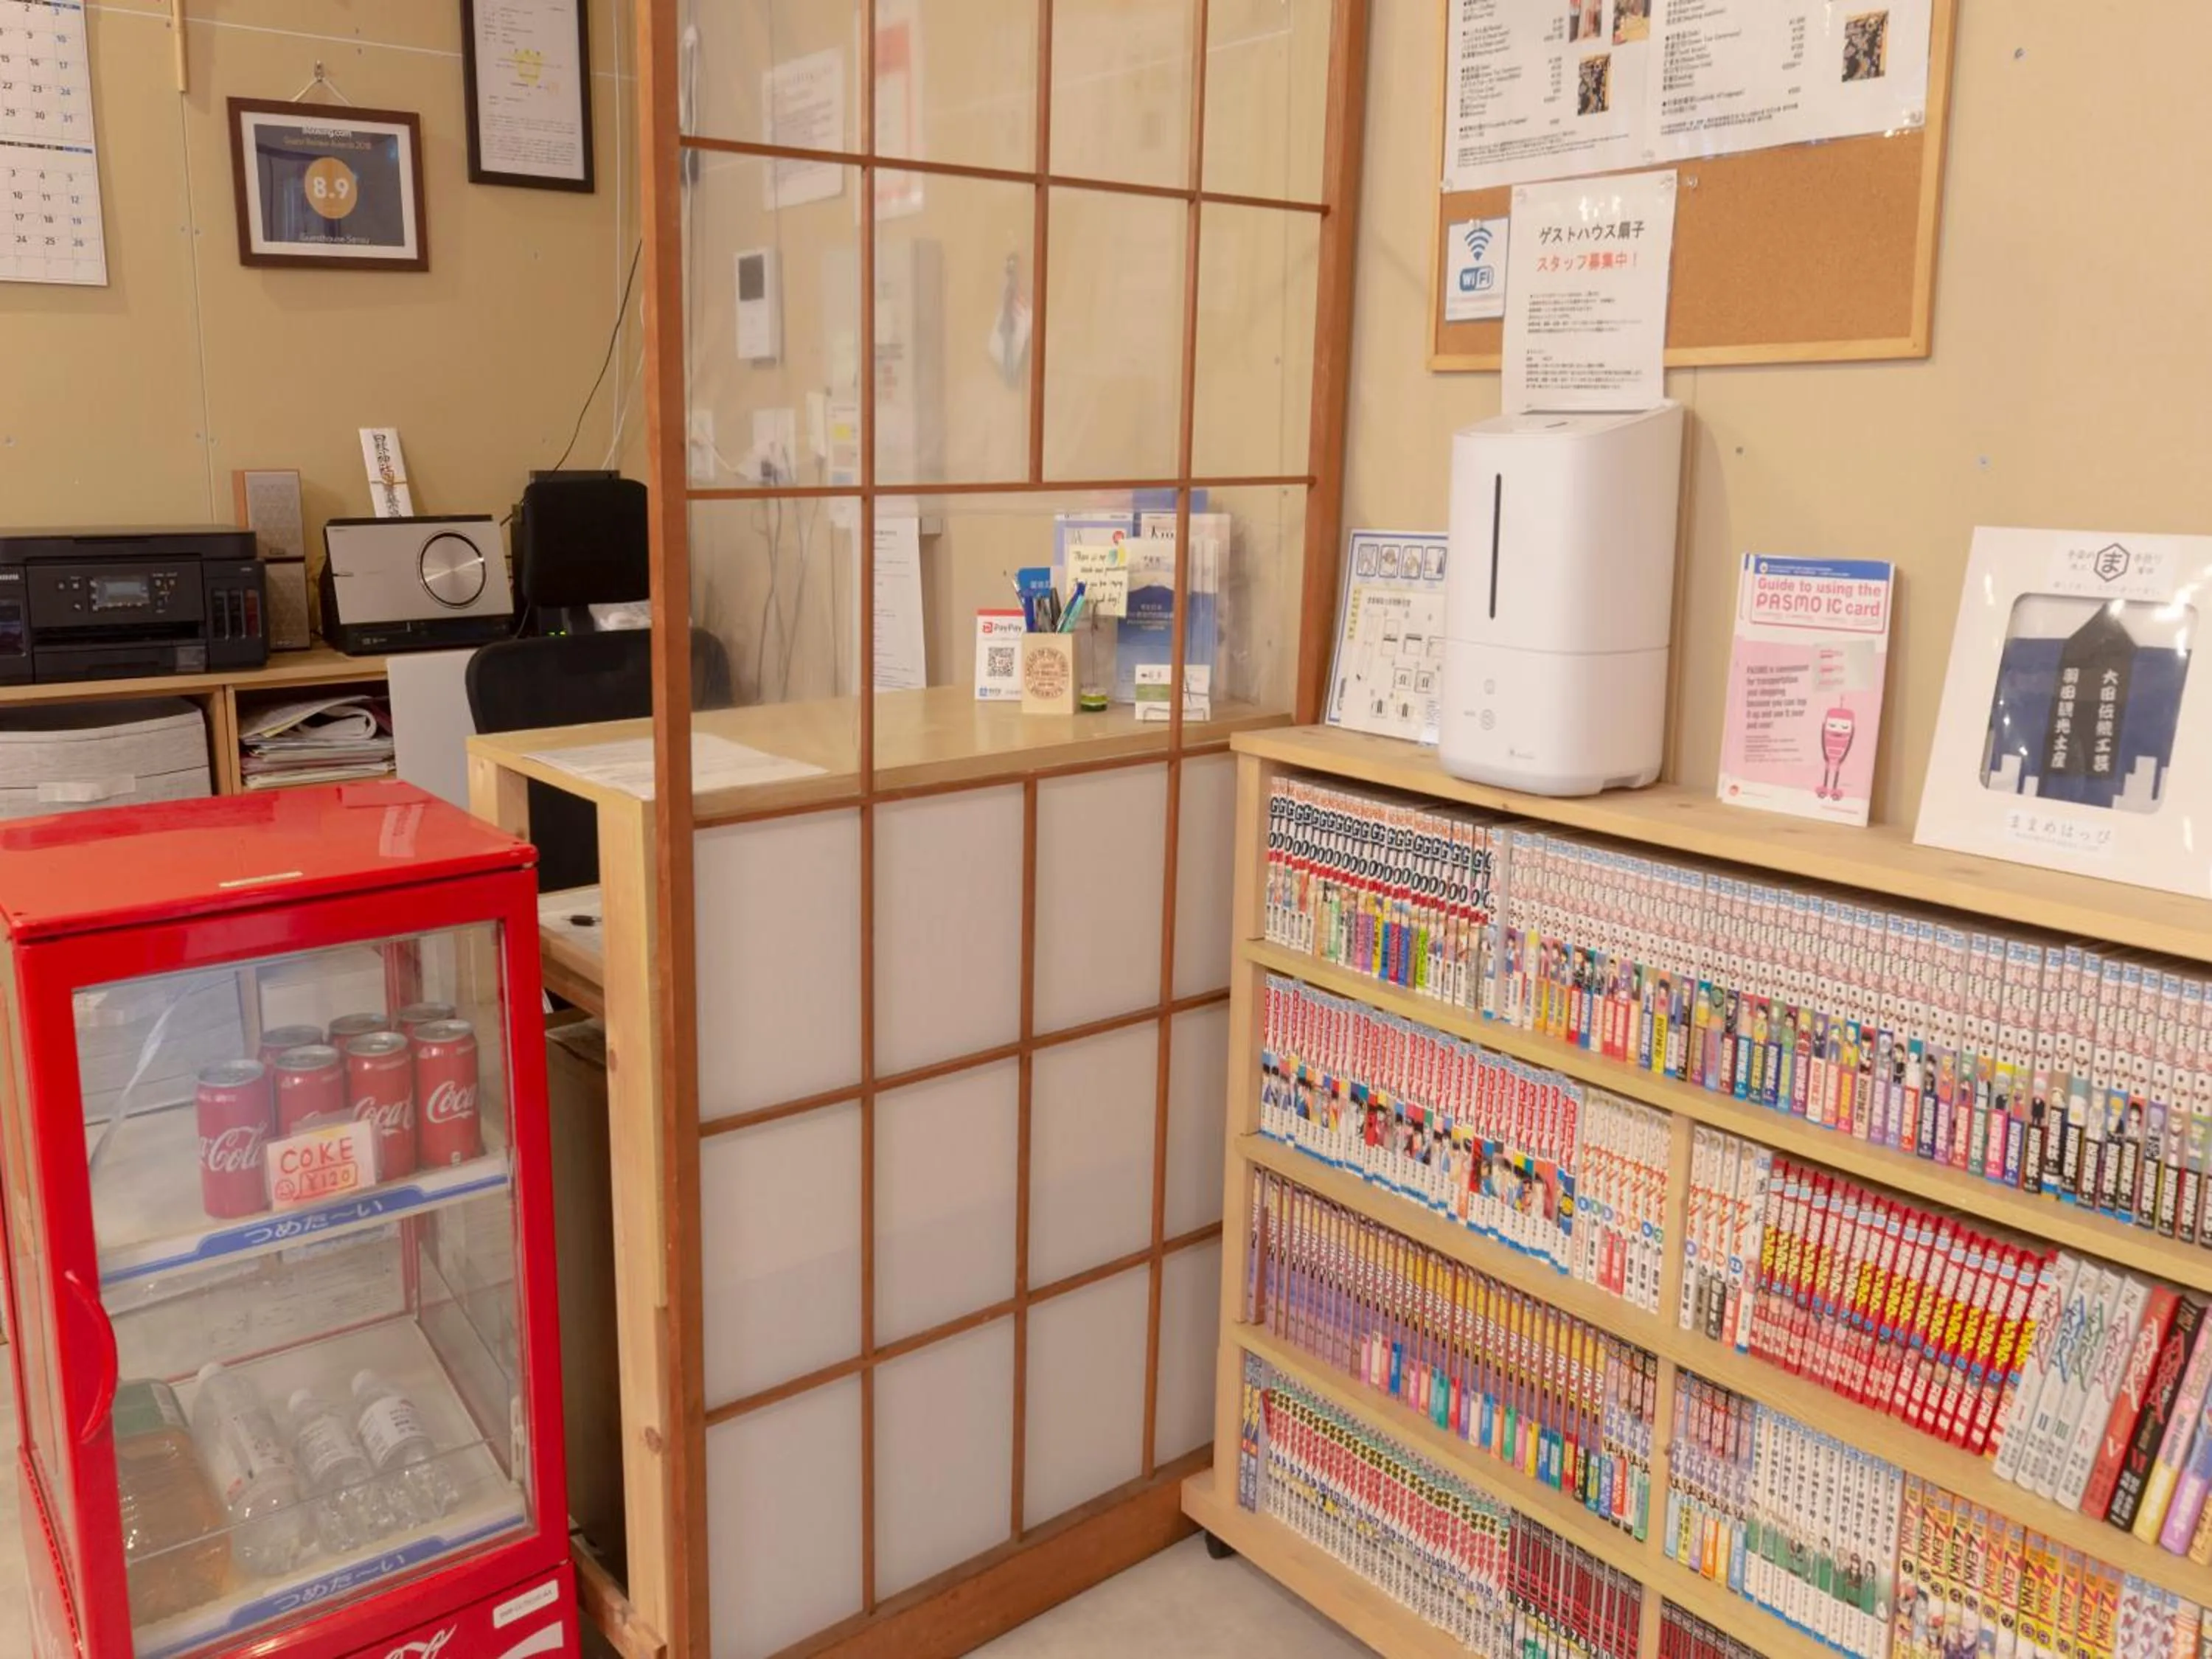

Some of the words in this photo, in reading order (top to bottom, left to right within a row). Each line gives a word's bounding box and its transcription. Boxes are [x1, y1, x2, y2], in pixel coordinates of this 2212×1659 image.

[313, 176, 349, 199] 8.9
[1539, 220, 1645, 246] ゲストハウス扇子
[1758, 578, 1795, 592] Guide
[1799, 581, 1812, 592] to
[1817, 580, 1853, 598] using
[1858, 583, 1882, 597] the
[2102, 550, 2123, 573] ま
[994, 623, 1023, 633] PayPay
[1756, 594, 1822, 612] PASMO
[1826, 599, 1843, 614] IC
[1846, 602, 1879, 616] card
[281, 1138, 354, 1174] COKE
[307, 1169, 352, 1192] ¥120
[1899, 1500, 1923, 1555] ZENKI
[1918, 1508, 1936, 1563] ZENKI
[1931, 1522, 1951, 1577] ZENKI
[1948, 1527, 1970, 1584] ZENKI
[1964, 1534, 1986, 1591] ZENKI
[1983, 1544, 2003, 1599] ZENKI
[2000, 1551, 2026, 1610] ZENKI
[2018, 1560, 2044, 1618] ZENKI
[2038, 1566, 2059, 1627] ZENKI
[2058, 1574, 2079, 1634] ZENKI
[2076, 1585, 2100, 1644] ZENKI
[2095, 1592, 2118, 1652] ZENKI
